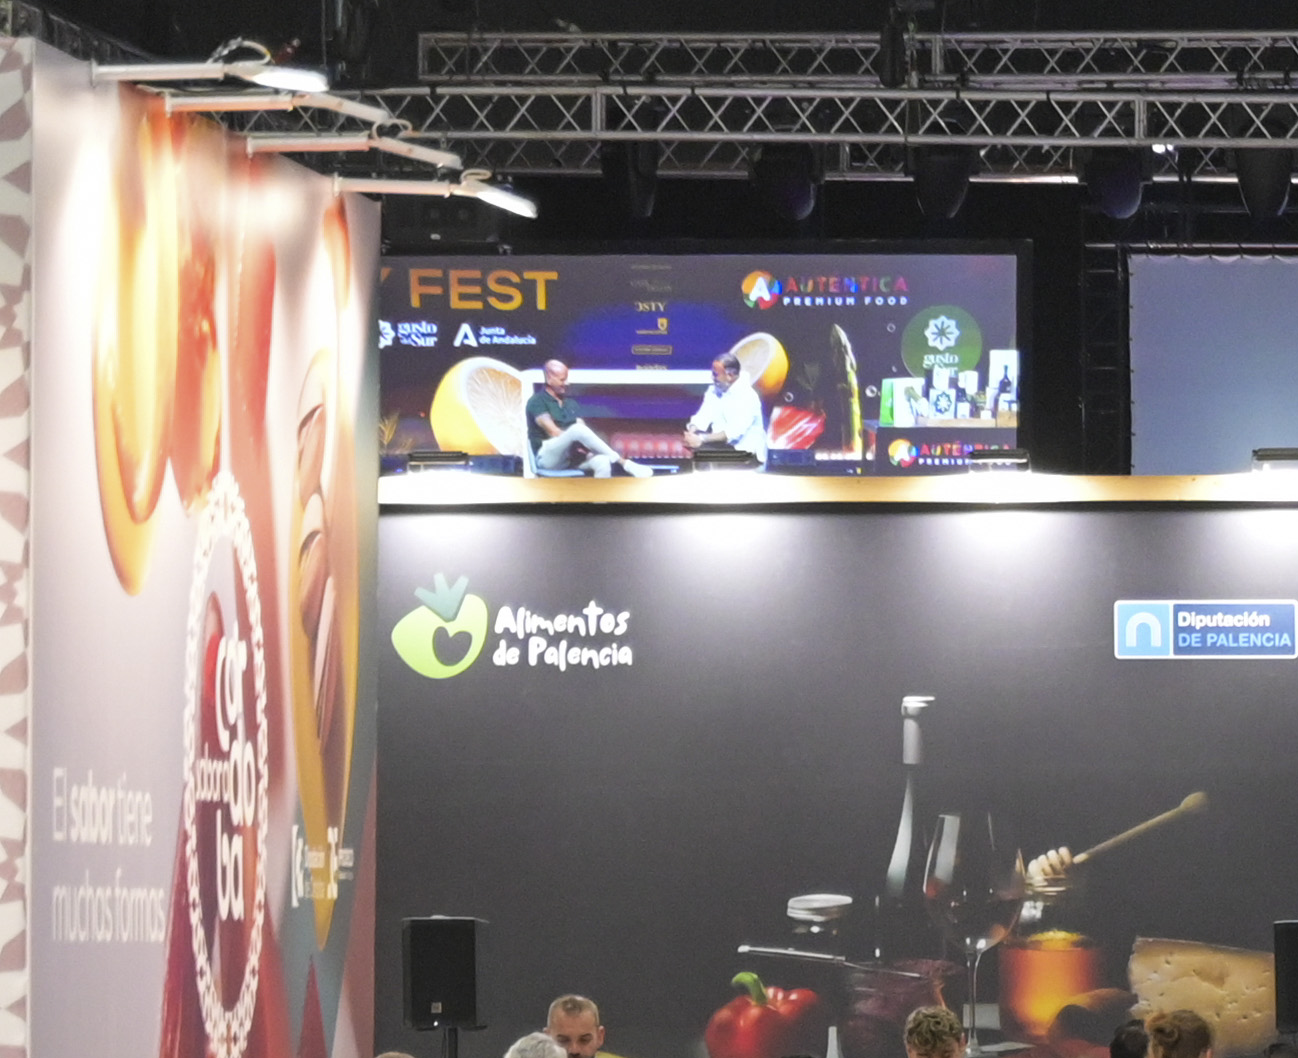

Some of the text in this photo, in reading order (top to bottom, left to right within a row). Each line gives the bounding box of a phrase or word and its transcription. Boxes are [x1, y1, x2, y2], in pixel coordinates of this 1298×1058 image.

[409, 268, 559, 311] FEST
[783, 296, 908, 306] PREMIUM FOOD
[397, 321, 438, 338] gusto
[479, 326, 506, 336] Junta
[410, 333, 438, 347] Sur
[922, 353, 960, 369] gusto
[494, 600, 631, 639] Alimentos
[1177, 611, 1271, 630] Diputación
[1178, 632, 1292, 647] DE PALENCIA
[492, 636, 633, 672] de Palencia
[53, 767, 153, 847] El sabor tiene
[52, 866, 166, 943] muchas formas
